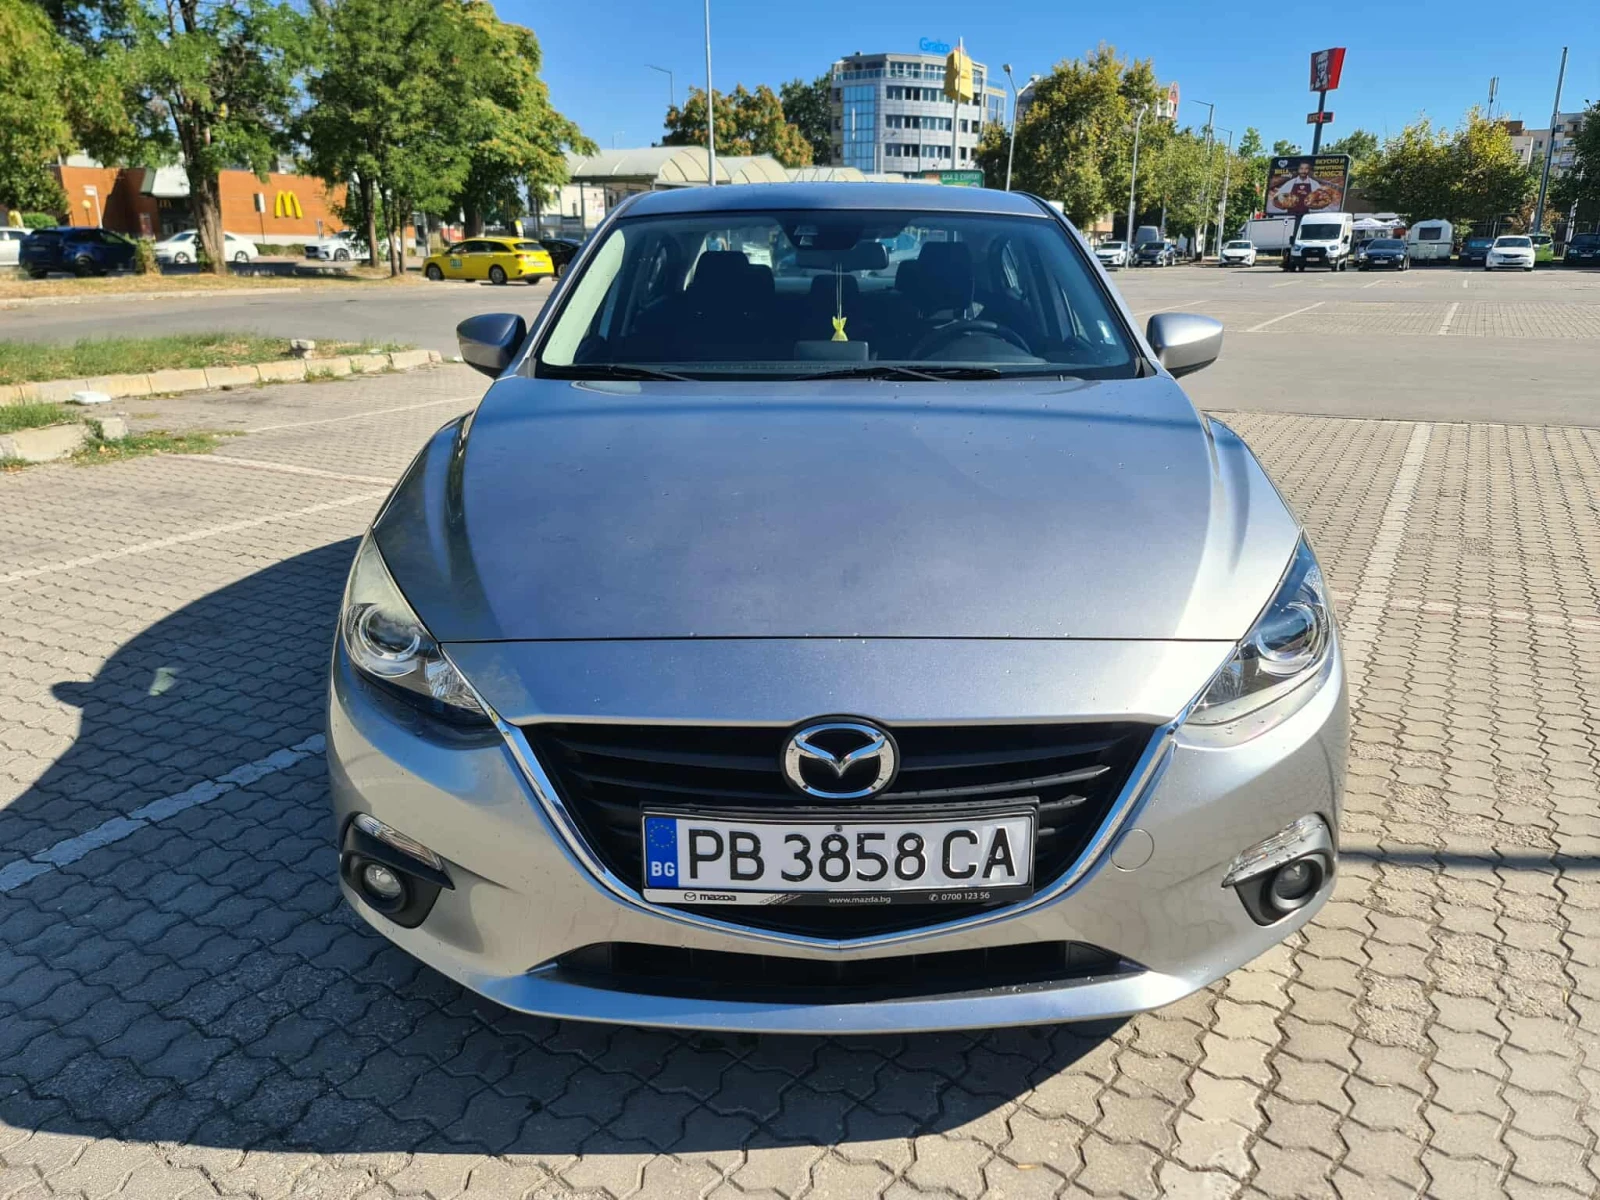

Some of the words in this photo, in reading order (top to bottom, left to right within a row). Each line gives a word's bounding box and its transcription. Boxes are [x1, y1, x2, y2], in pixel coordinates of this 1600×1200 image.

[688, 828, 765, 881] PB
[781, 832, 926, 882] 3858
[942, 827, 1016, 880] CA
[651, 861, 675, 877] BG
[828, 896, 892, 904] www.mazda.bg
[941, 892, 962, 902] 0700
[964, 892, 978, 901] 123
[979, 891, 990, 900] 56
